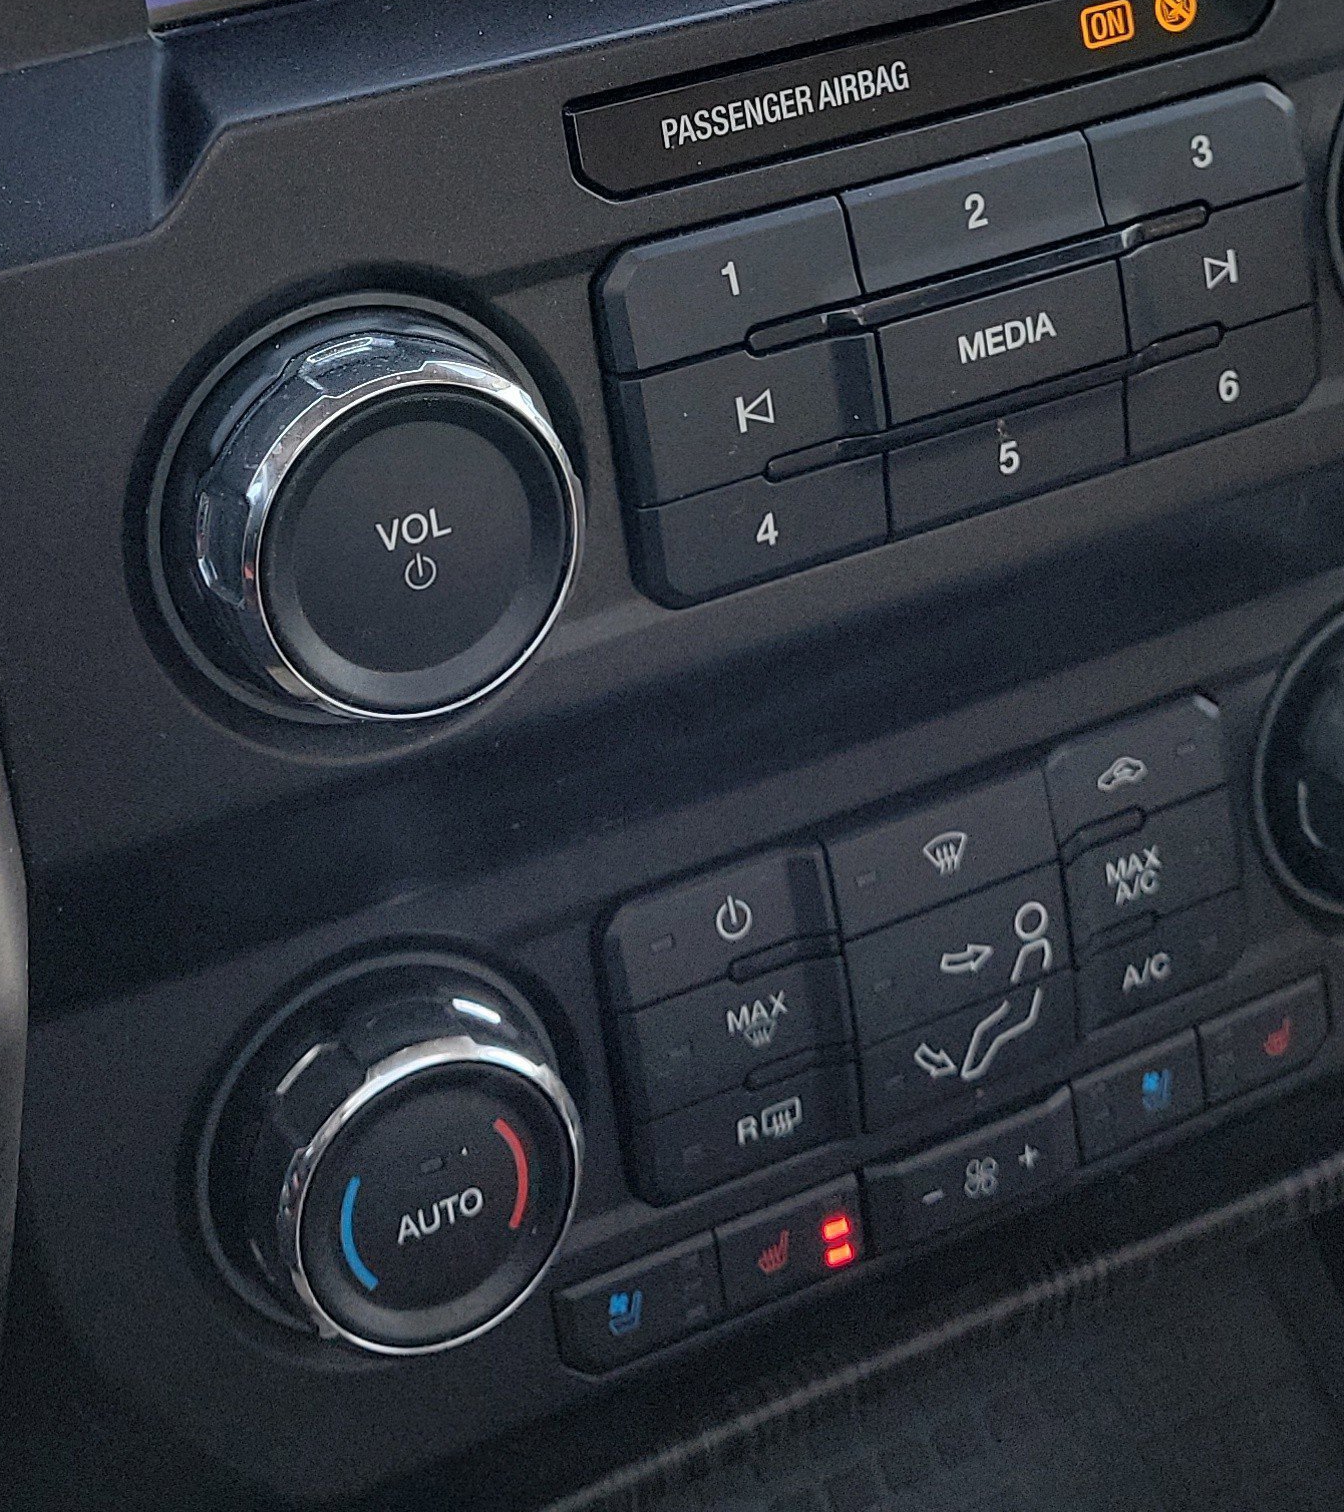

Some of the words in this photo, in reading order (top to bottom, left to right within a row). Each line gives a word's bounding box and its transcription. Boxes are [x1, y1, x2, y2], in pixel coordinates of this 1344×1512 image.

[1090, 14, 1127, 41] ON
[661, 84, 815, 150] PASSENGER
[818, 60, 910, 111] AIRBAG
[1191, 135, 1213, 169] 3
[964, 193, 989, 230] 2
[720, 261, 741, 296] 1
[958, 311, 1057, 364] MEDIA
[1218, 370, 1240, 403] 6
[997, 441, 1021, 476] 5
[375, 507, 453, 552] VOL
[755, 511, 779, 548] 4
[1105, 845, 1162, 885] MAX
[1115, 869, 1158, 906] A/C
[1122, 952, 1172, 993] A/C
[727, 990, 789, 1034] MAX
[737, 1116, 759, 1145] R
[397, 1187, 484, 1246] AUTO
